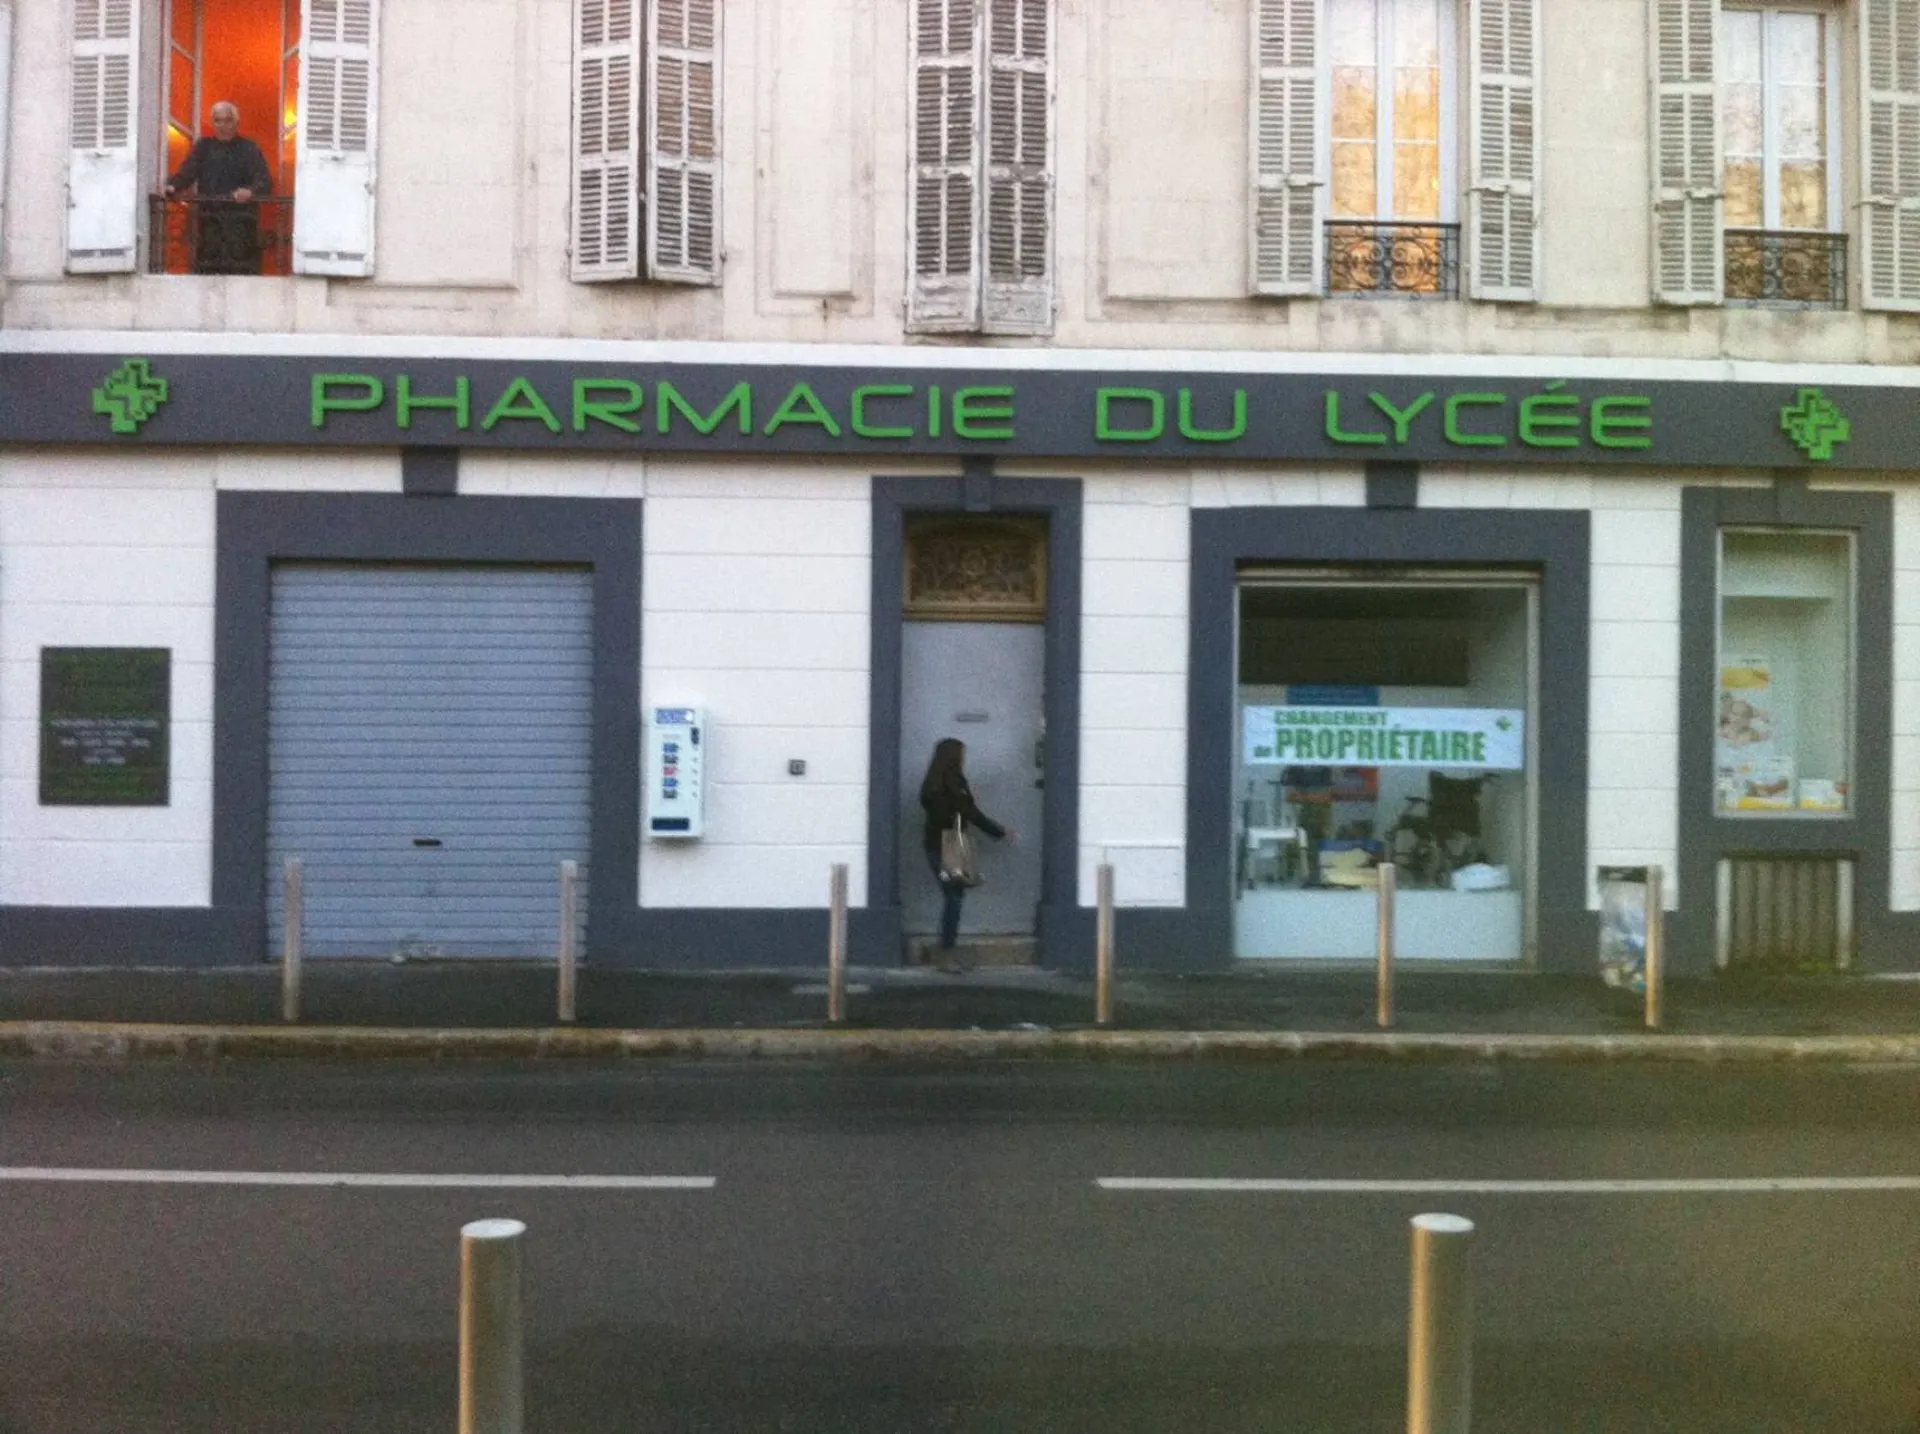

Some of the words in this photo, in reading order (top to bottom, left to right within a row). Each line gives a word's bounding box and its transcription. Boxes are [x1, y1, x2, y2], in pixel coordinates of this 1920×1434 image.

[310, 372, 1015, 440] PHARMACIE
[1095, 386, 1247, 442] DU
[1325, 379, 1652, 448] LYCÉE
[1274, 710, 1388, 726] CHANGEMENT
[1276, 724, 1486, 762] PROPRIÉTAIRE
